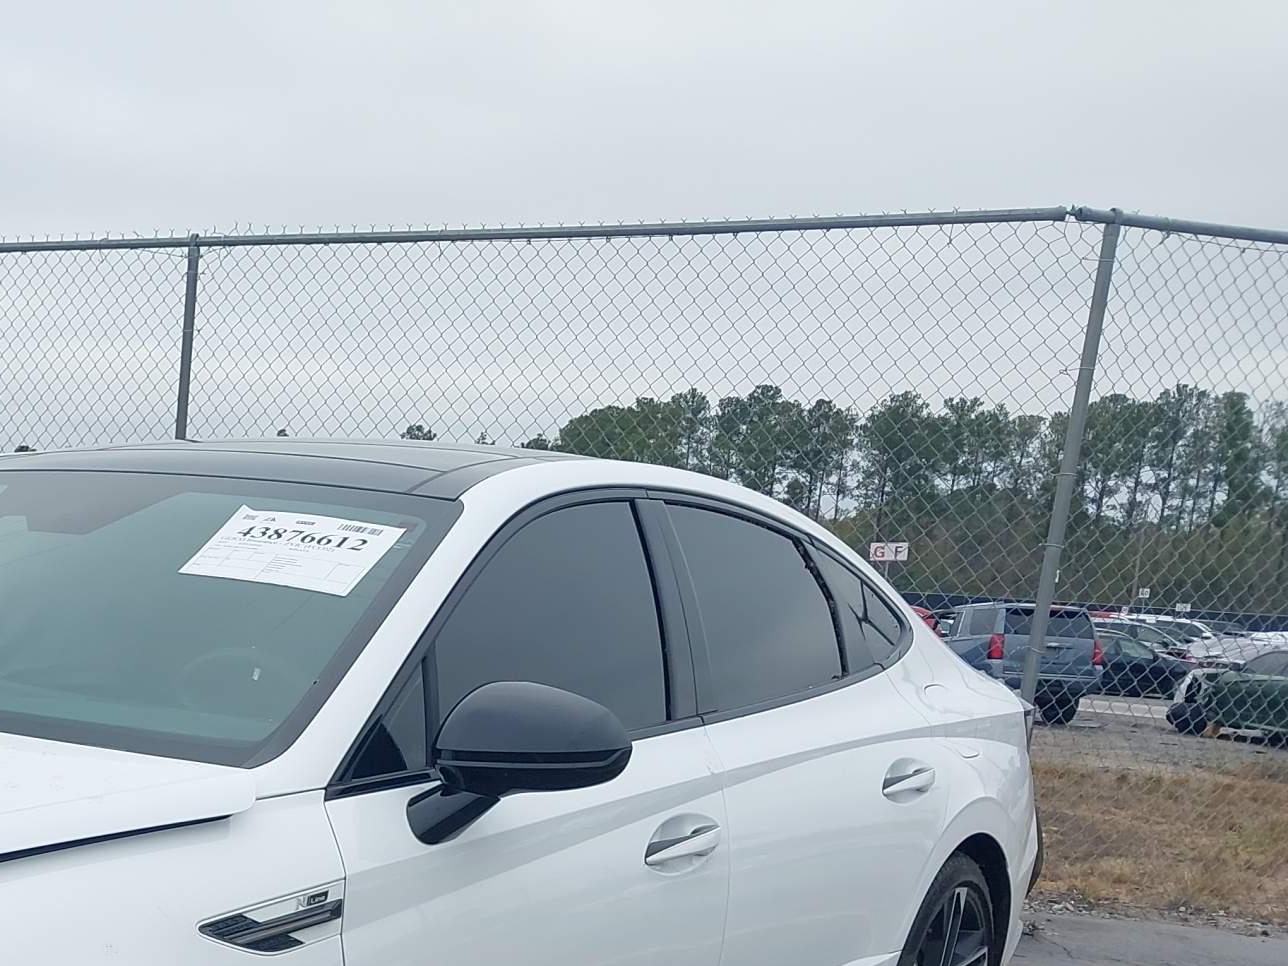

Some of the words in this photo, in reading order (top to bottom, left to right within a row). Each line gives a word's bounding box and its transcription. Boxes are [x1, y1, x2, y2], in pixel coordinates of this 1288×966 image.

[237, 524, 368, 552] 43876612
[874, 545, 885, 558] G
[894, 546, 903, 560] F
